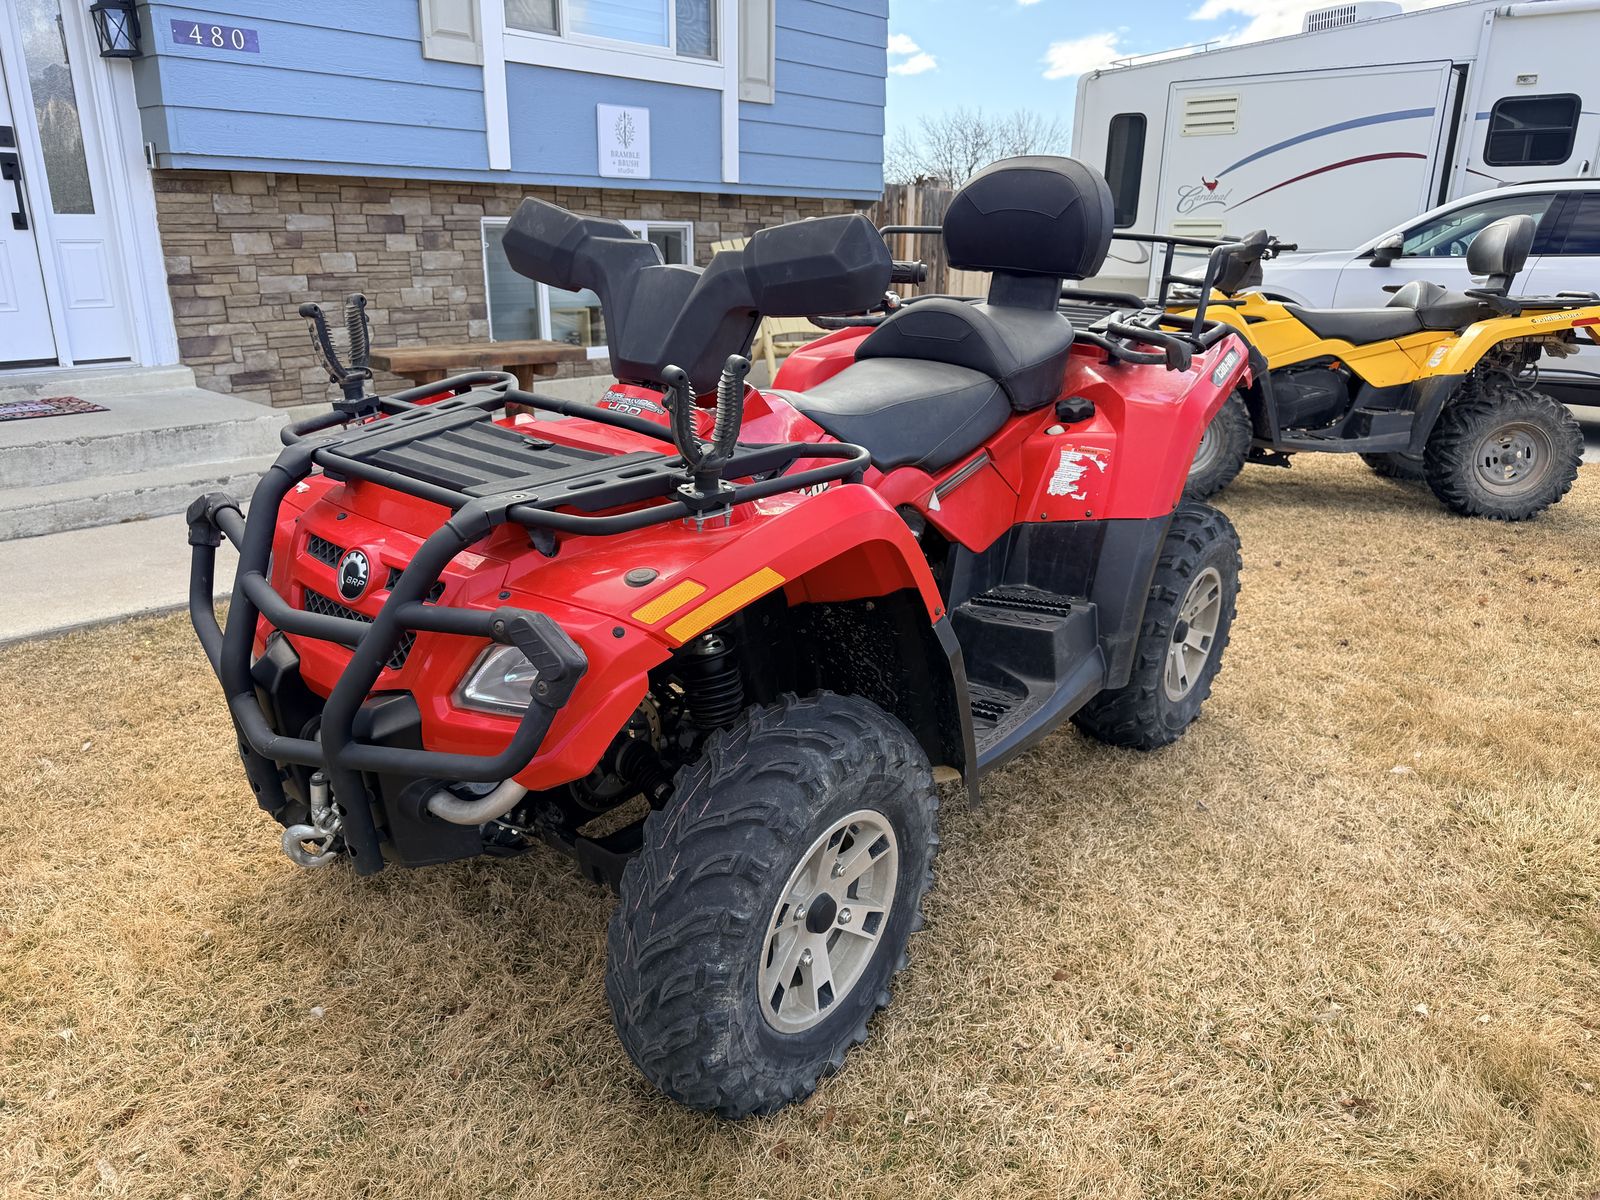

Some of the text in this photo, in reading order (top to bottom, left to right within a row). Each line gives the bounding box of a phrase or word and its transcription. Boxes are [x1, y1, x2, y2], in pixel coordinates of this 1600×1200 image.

[189, 24, 244, 50] 480
[611, 150, 640, 159] BRAMBLE
[1177, 185, 1232, 213] Cardinal
[608, 402, 642, 416] 400
[346, 576, 365, 587] BRP
